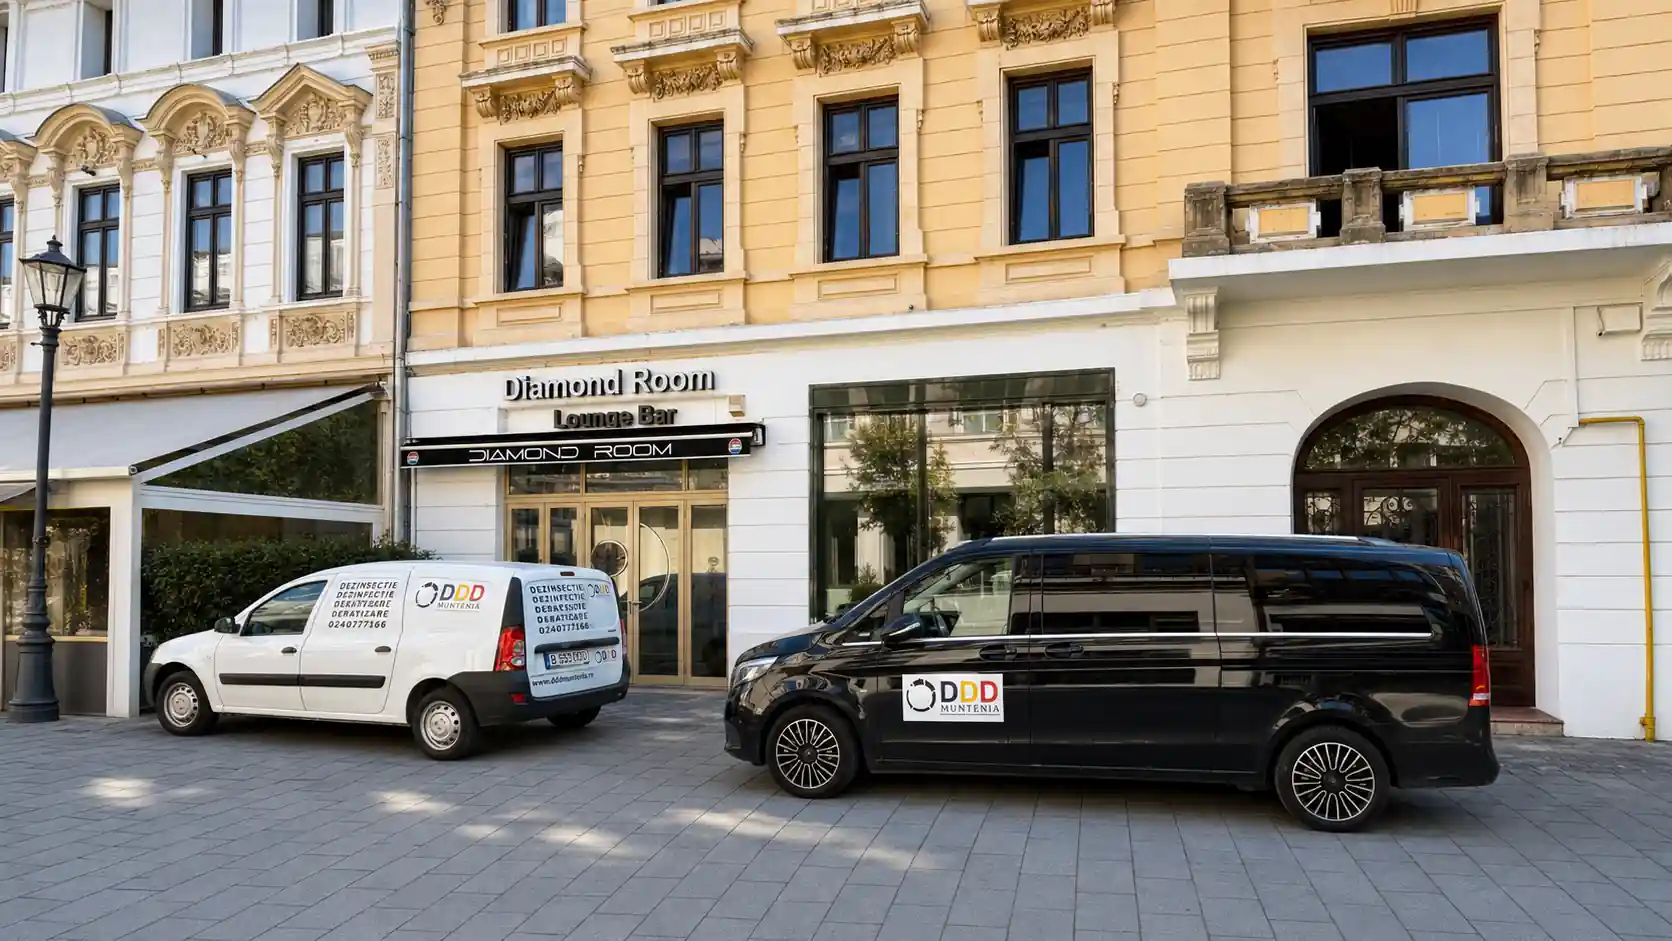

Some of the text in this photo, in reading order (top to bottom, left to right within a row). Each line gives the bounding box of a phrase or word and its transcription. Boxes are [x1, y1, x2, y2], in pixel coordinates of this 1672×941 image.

[503, 368, 715, 401] Diamond Room
[553, 404, 678, 429] Lounge Bar
[468, 443, 672, 462] DIAMOND ROOM
[340, 582, 398, 590] DEZINSECTIE
[439, 584, 485, 601] DDD
[437, 602, 481, 610] MUNTENIA
[328, 620, 387, 629] 0240777166
[940, 680, 999, 703] DDD
[940, 704, 1000, 713] MUNTENIA
